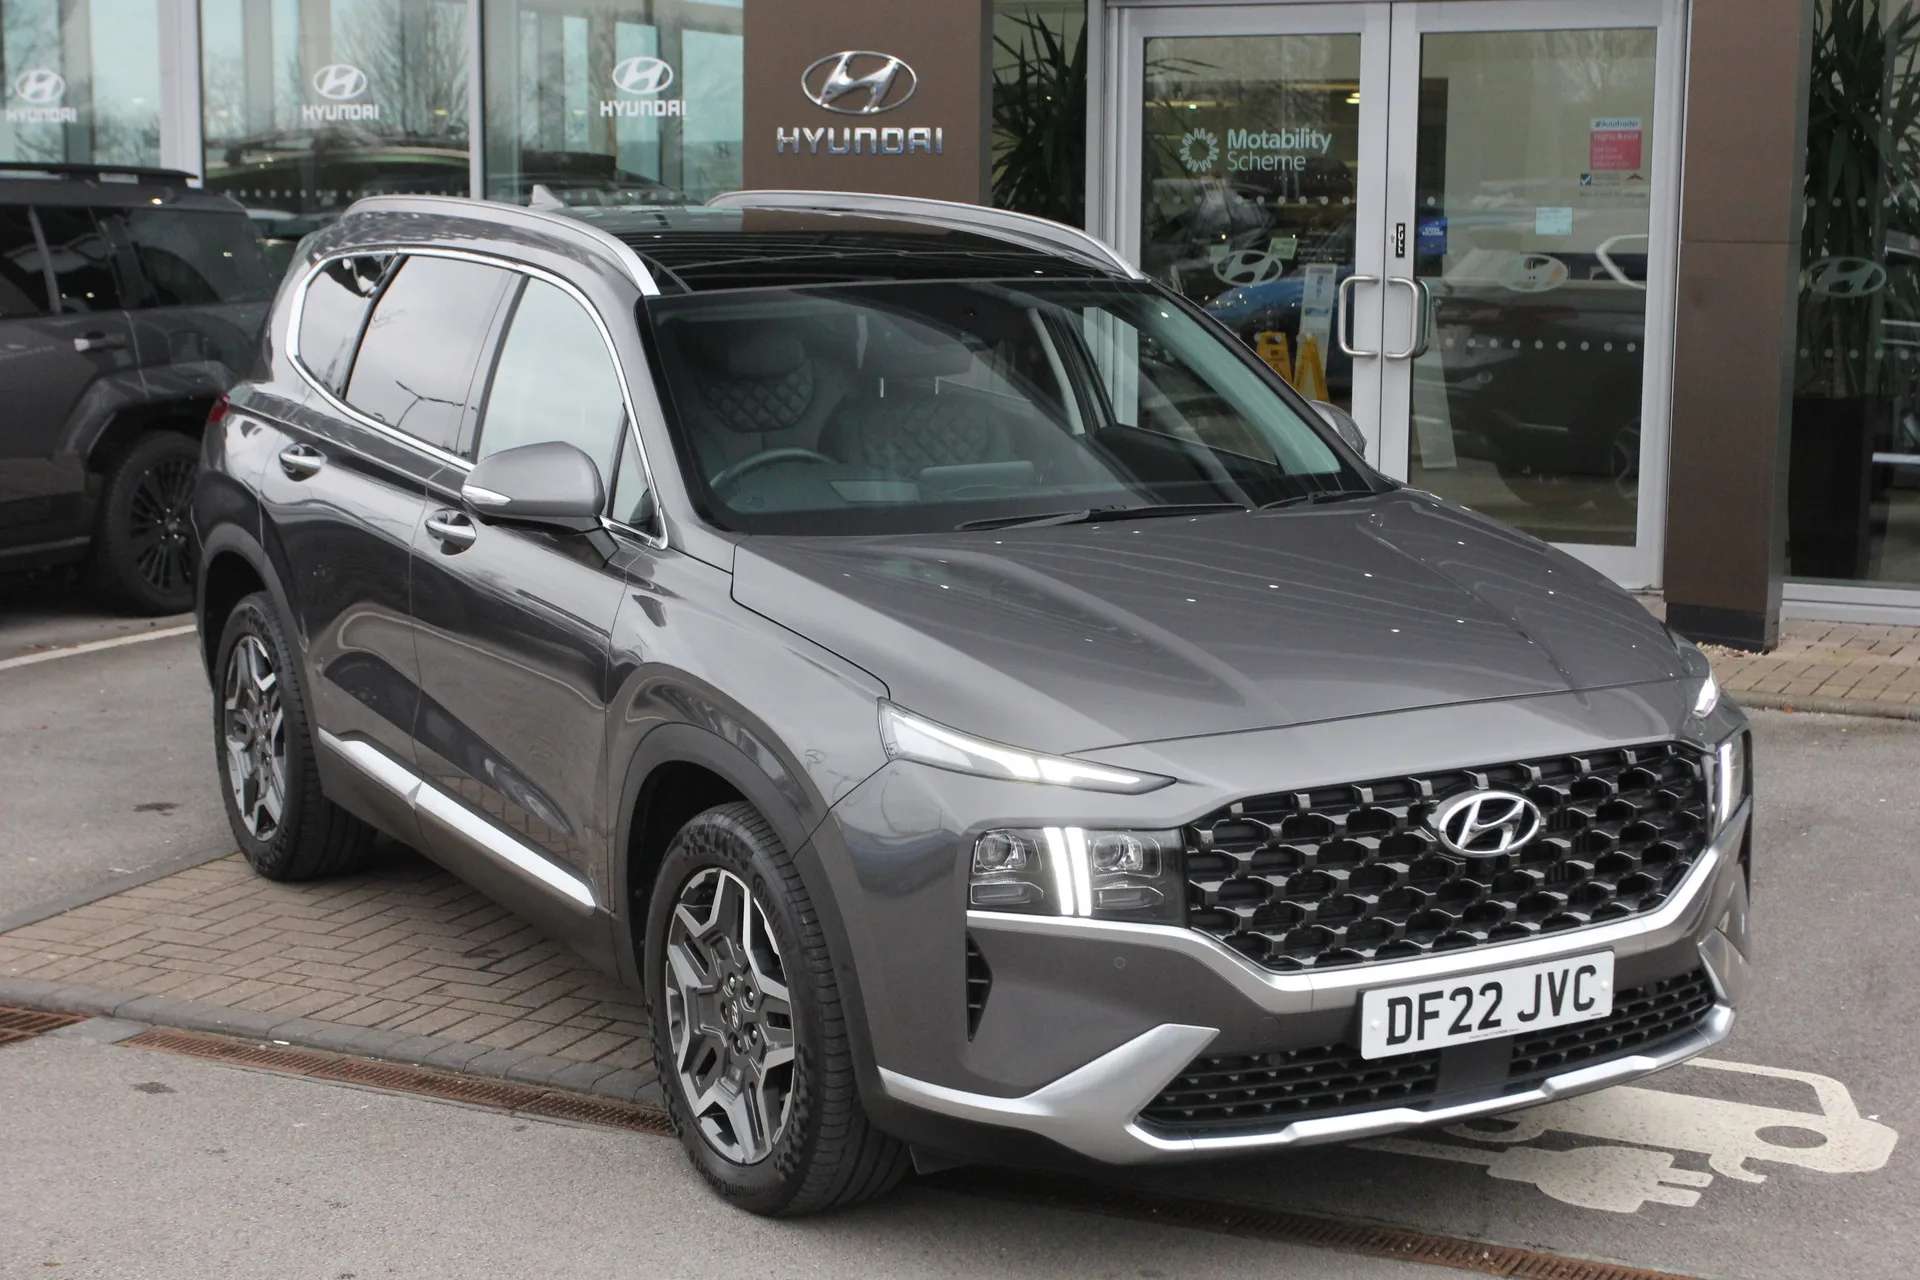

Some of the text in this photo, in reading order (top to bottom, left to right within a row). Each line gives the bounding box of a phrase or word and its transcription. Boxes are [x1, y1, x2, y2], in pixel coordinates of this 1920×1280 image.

[6, 107, 77, 123] HYUNDAI
[302, 104, 380, 121] HYUNDAI
[600, 100, 687, 117] HYUNDAI
[776, 126, 944, 155] HYUNDAI
[1227, 127, 1333, 154] Motability
[1227, 151, 1307, 172] Scheme
[1386, 964, 1597, 1047] DF22 JVC
